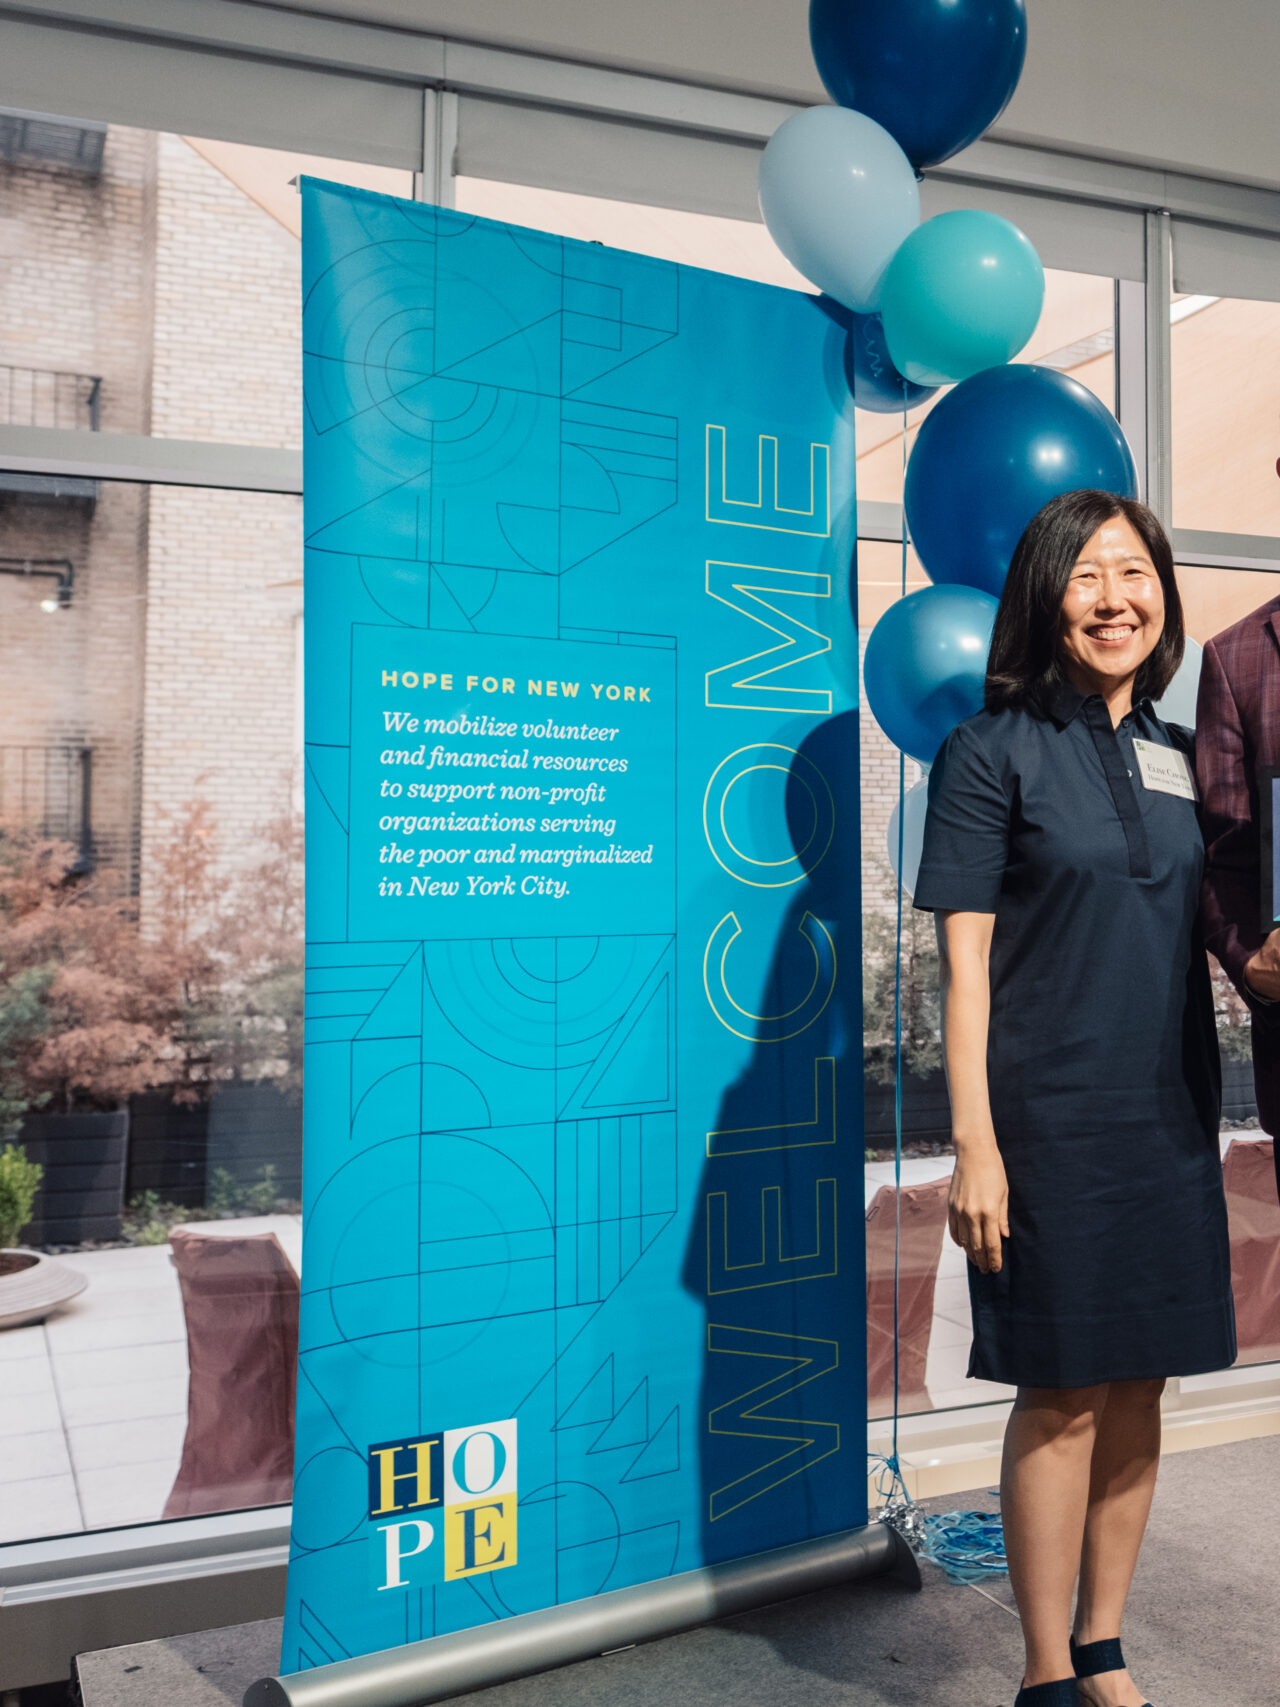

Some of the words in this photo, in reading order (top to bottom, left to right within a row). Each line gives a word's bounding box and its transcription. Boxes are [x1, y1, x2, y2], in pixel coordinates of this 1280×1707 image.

[381, 670, 453, 690] HOPE
[466, 676, 516, 694] FOR
[527, 680, 580, 698] NEW
[591, 684, 651, 702] YORK
[382, 712, 419, 733] We
[424, 714, 518, 737] mobilize
[522, 719, 619, 741] volunteer
[380, 745, 425, 765] and
[426, 746, 528, 769] financial
[533, 756, 628, 772] resources
[380, 780, 402, 798] to
[407, 783, 496, 802] support
[500, 783, 606, 805] non-profit
[379, 812, 536, 834] organizations
[540, 814, 616, 836] serving
[379, 843, 415, 864] the
[417, 849, 470, 867] poor
[474, 844, 516, 864] and
[519, 844, 653, 867] marginalized
[378, 877, 402, 896] in
[407, 877, 460, 896] New
[466, 875, 516, 896] York
[521, 875, 570, 898] City.
[703, 424, 840, 1522] WELCOME
